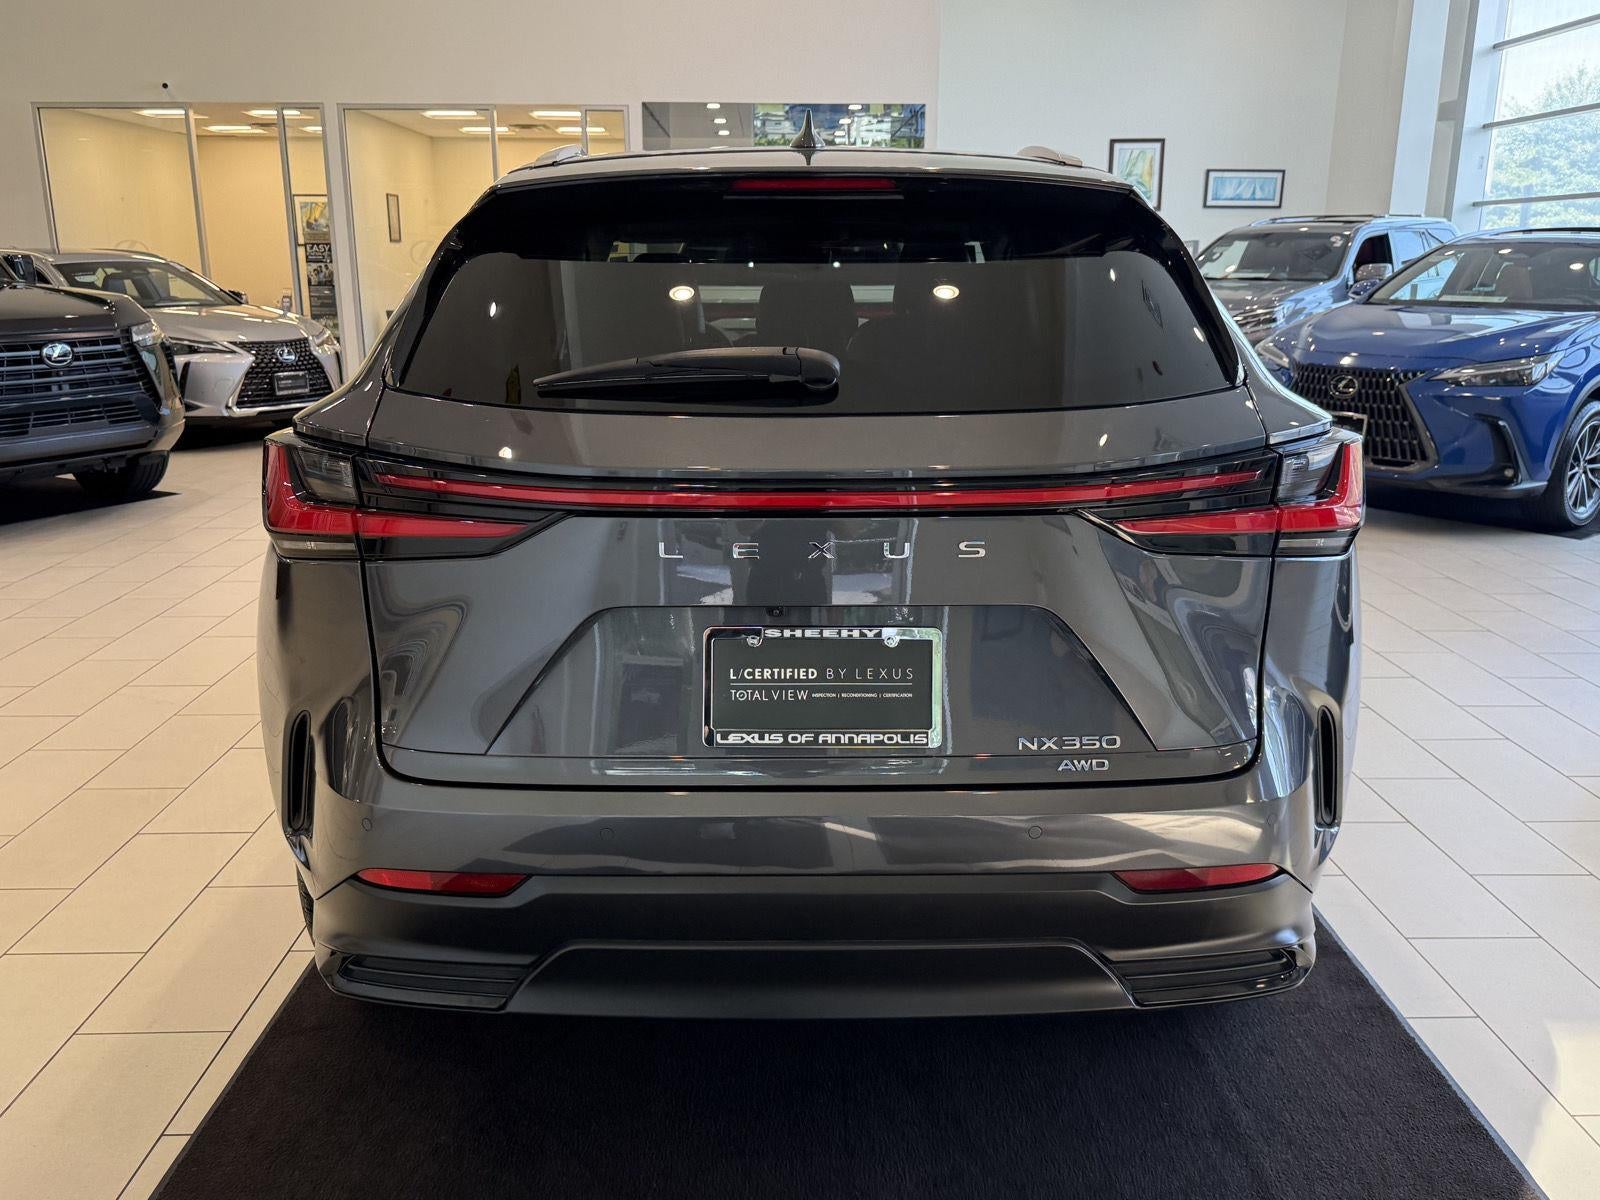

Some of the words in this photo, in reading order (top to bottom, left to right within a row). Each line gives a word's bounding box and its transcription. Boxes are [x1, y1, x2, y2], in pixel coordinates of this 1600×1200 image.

[306, 244, 330, 253] EASY
[658, 541, 986, 559] LEXUS
[764, 629, 881, 638] SHEEHY
[730, 668, 818, 680] L/CERTIFIED
[826, 668, 847, 680] BY
[855, 668, 913, 680] LEXUS
[730, 689, 769, 701] TOTAL
[771, 689, 809, 701] VIEW
[716, 733, 784, 745] LEXUS
[787, 733, 814, 745] OF
[818, 732, 928, 744] ANNAPOLIS
[1057, 759, 1110, 772] AWD
